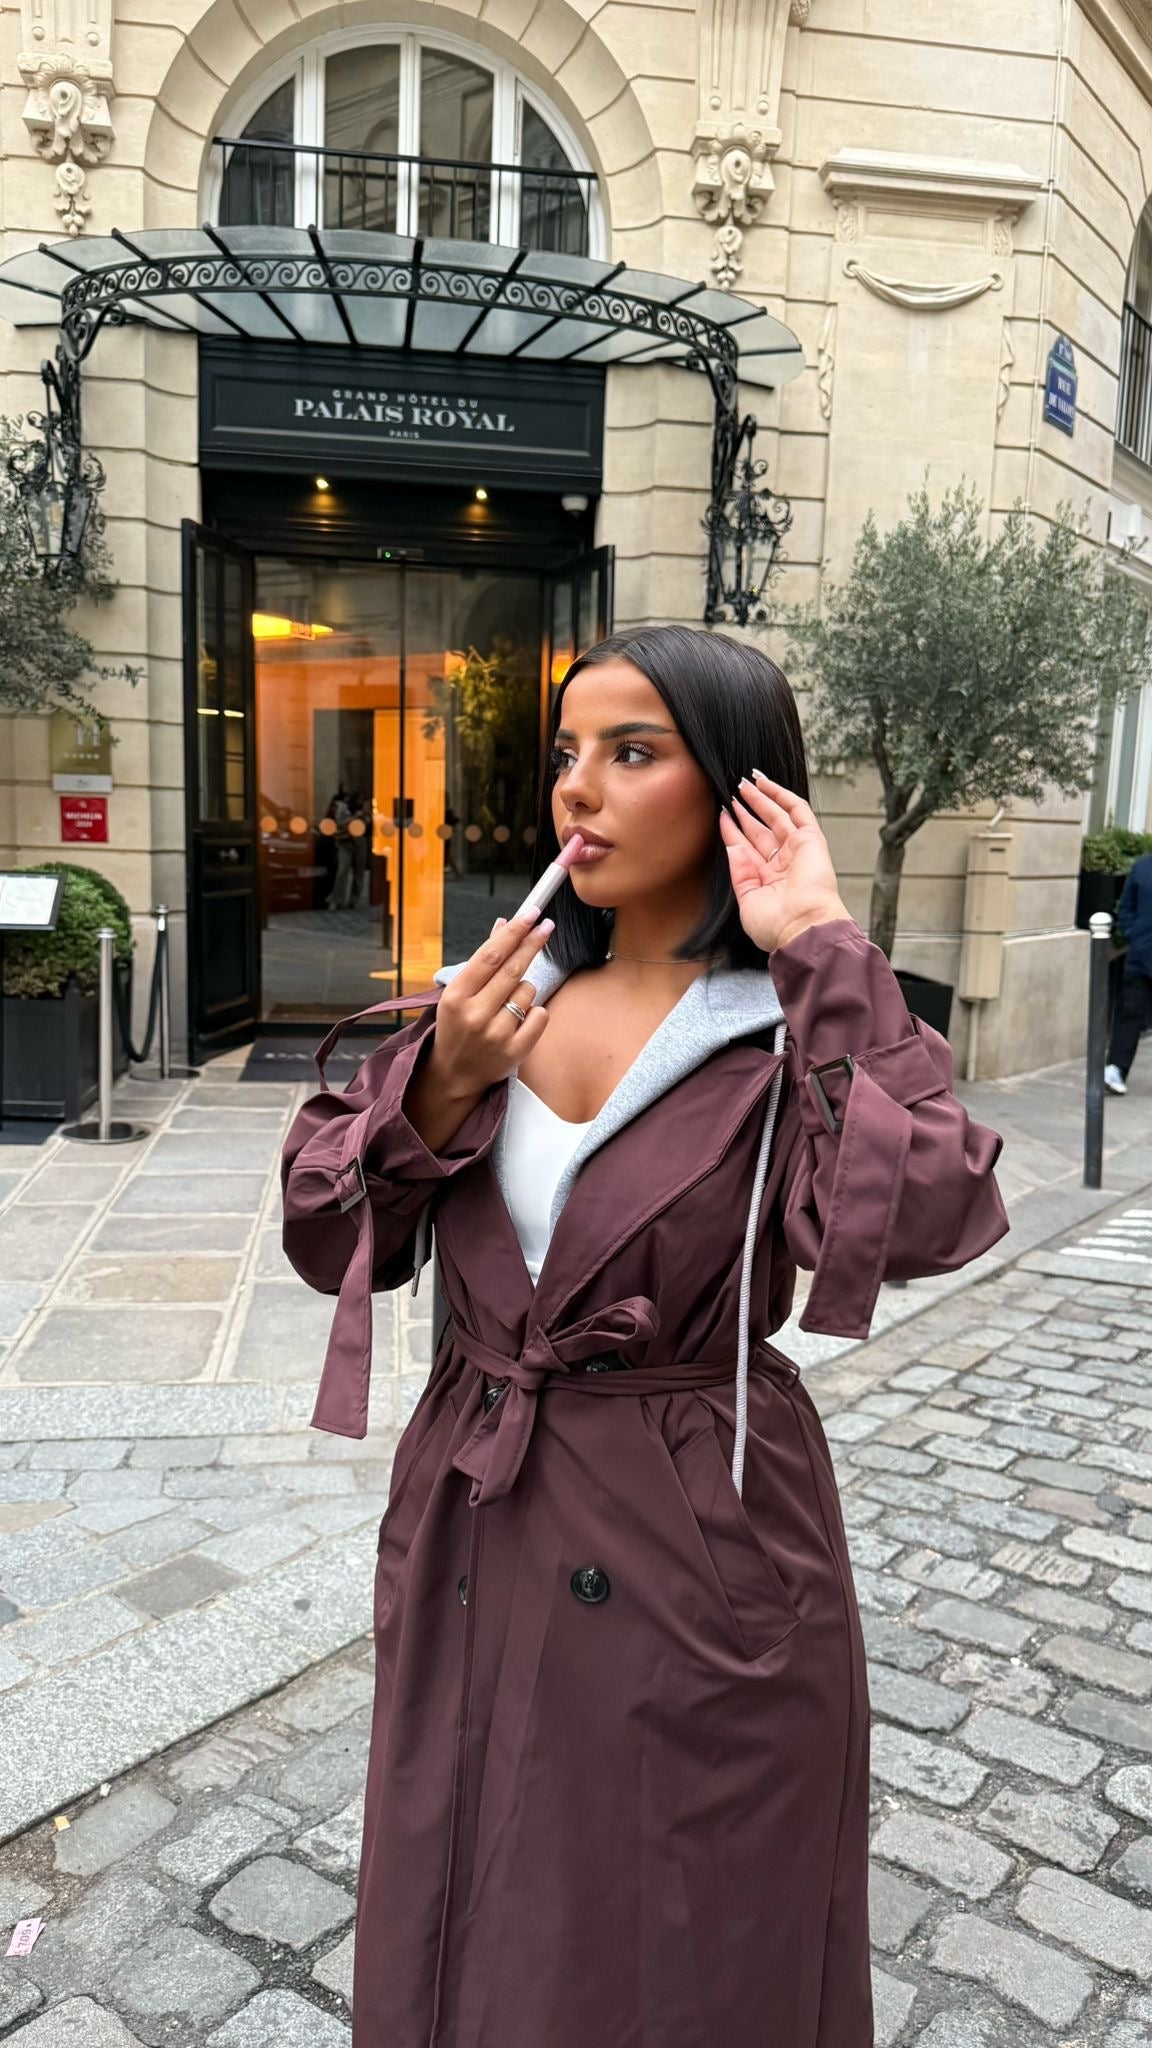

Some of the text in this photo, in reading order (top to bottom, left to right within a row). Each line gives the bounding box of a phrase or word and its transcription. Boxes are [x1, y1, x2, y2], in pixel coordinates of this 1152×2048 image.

[332, 389, 478, 409] GRAND HÔTEL DU
[294, 399, 515, 432] PALAIS ROYAL
[388, 429, 420, 439] PARIS
